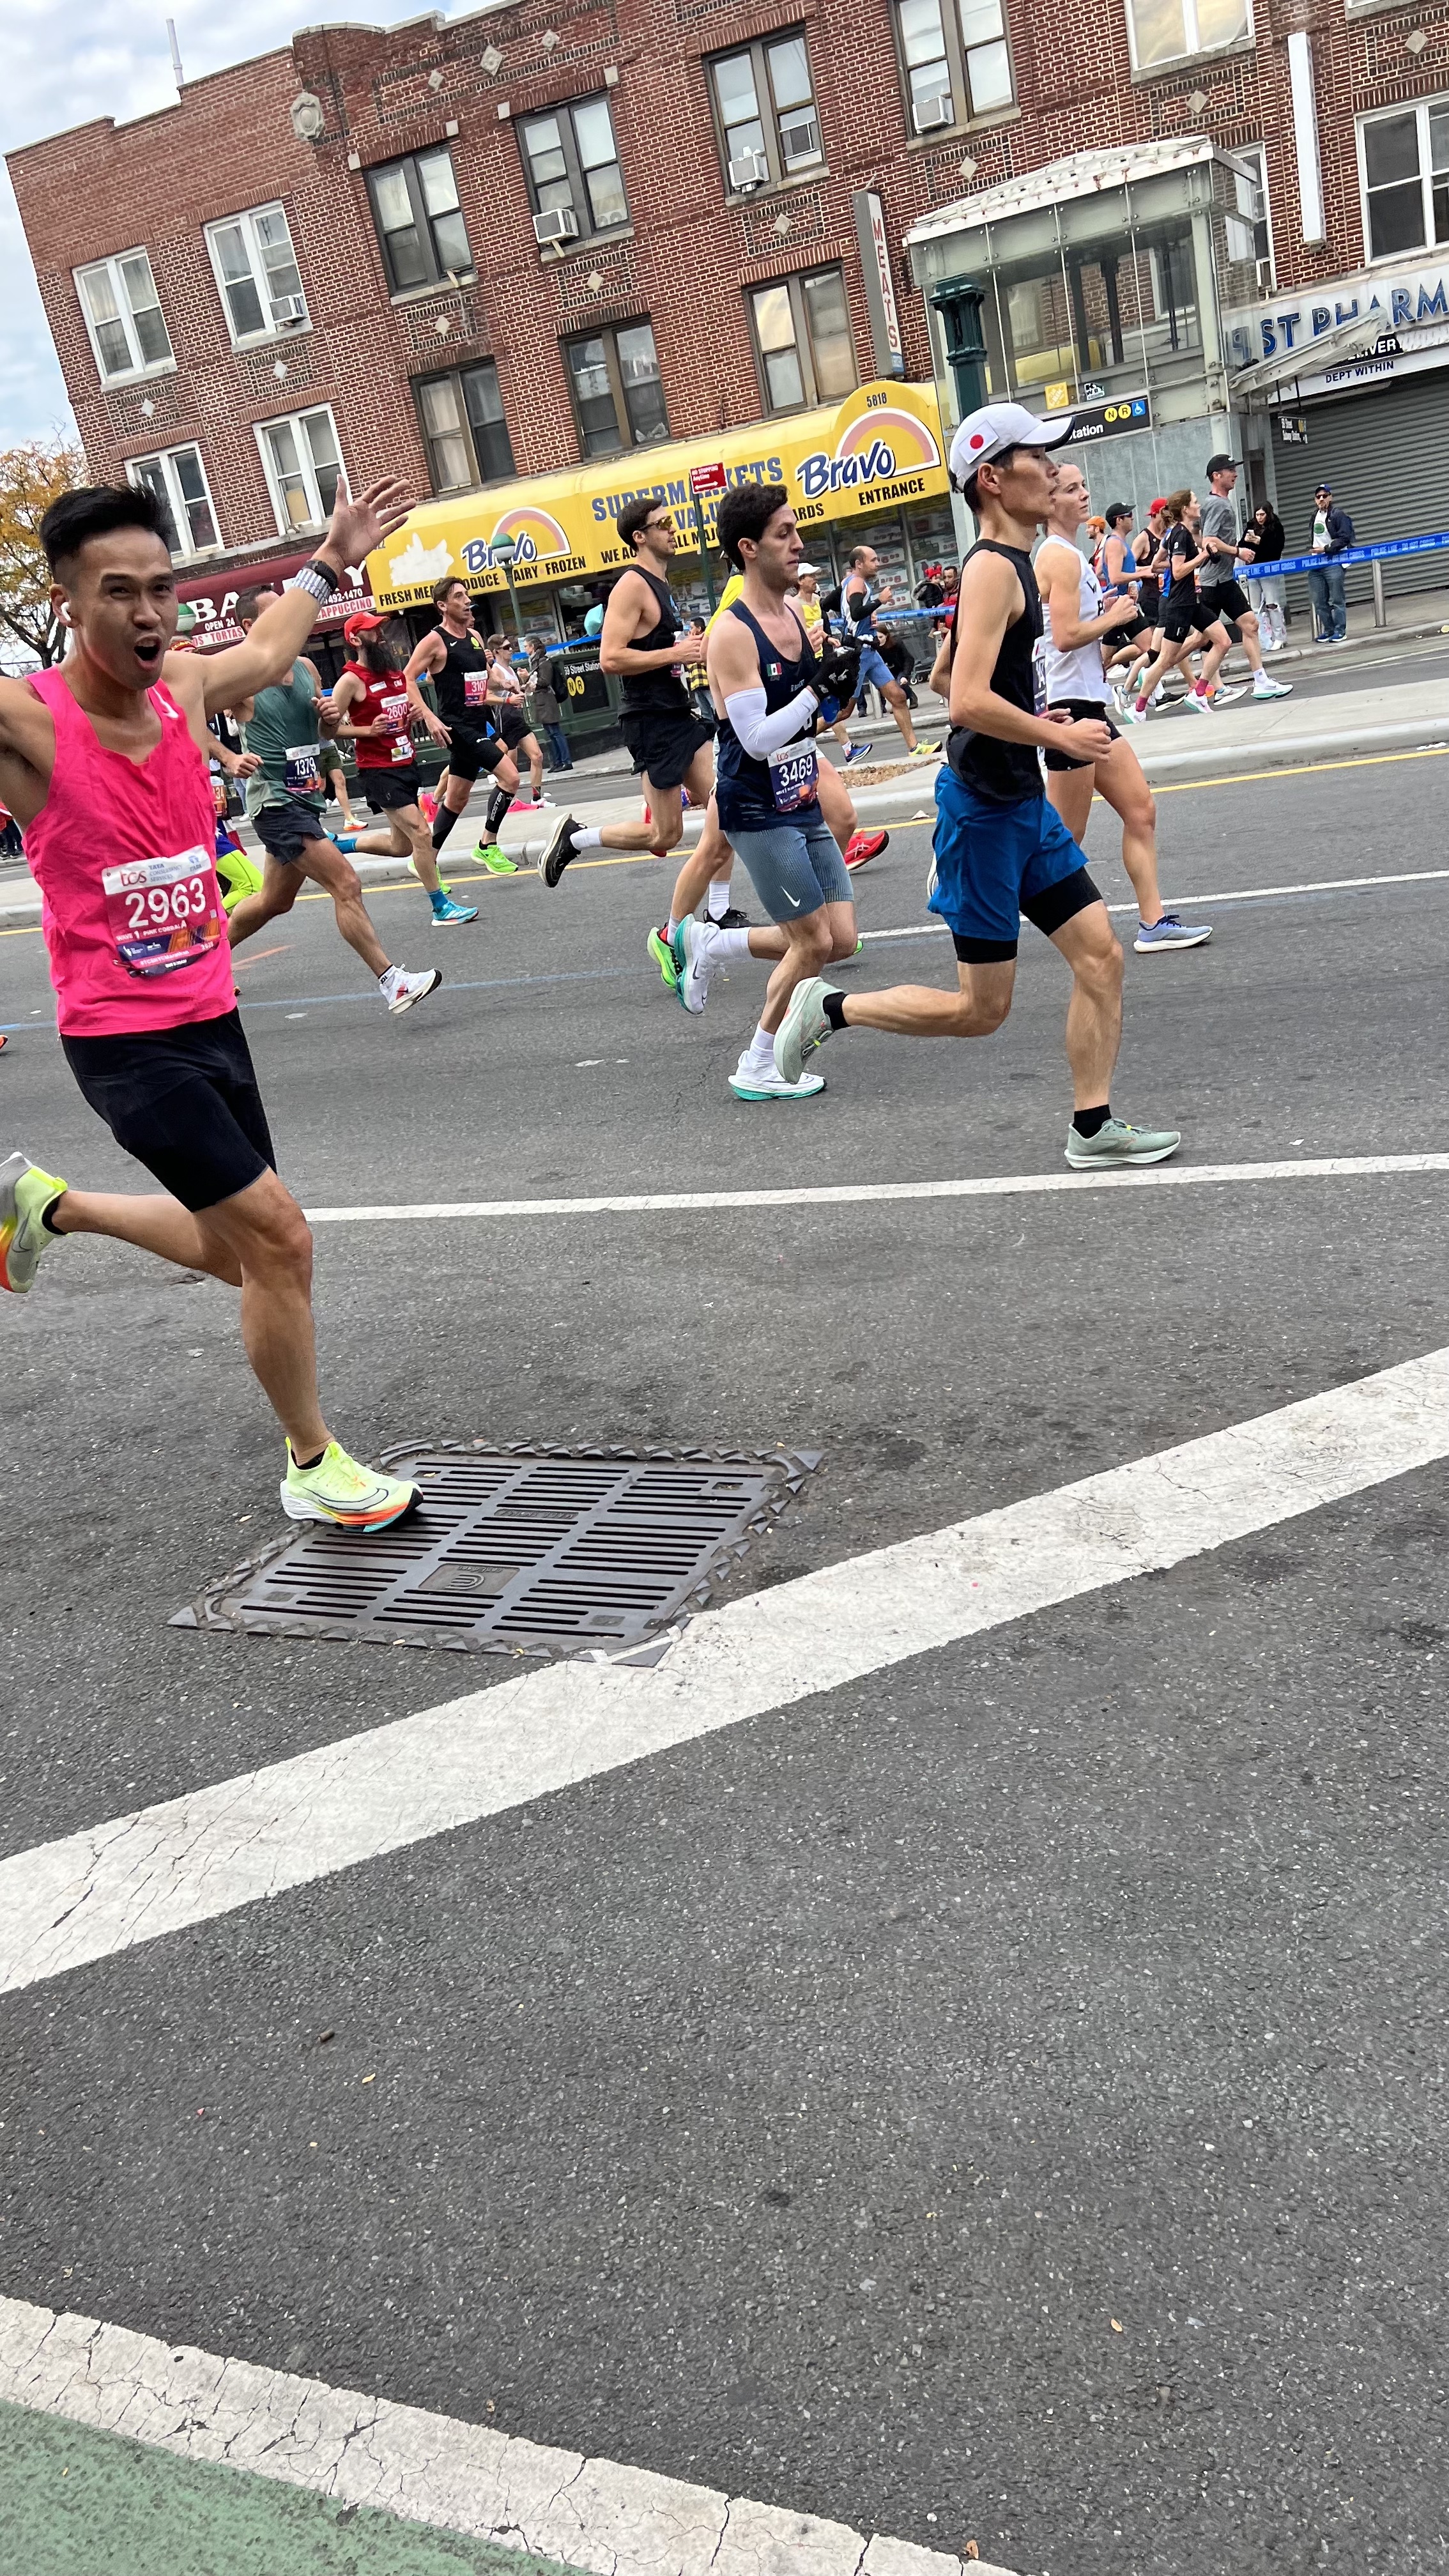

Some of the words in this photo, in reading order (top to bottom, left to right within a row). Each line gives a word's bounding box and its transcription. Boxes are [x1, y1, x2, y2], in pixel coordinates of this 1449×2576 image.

[871, 217, 898, 348] MEATS
[1260, 312, 1301, 356] ST
[1326, 370, 1352, 383] DEPT
[1355, 360, 1394, 376] WITHIN
[796, 440, 894, 496] Bravo
[591, 456, 783, 521] SUPRMKETS
[859, 477, 926, 506] ENTRANCE
[601, 548, 620, 564] WE
[792, 502, 824, 521] RDS
[462, 532, 536, 572] Brvo
[379, 589, 413, 606] FRESH
[464, 572, 500, 591] ODUCE
[513, 565, 538, 582] AIRY
[545, 555, 586, 576] FROZEN
[204, 619, 224, 632] OPEN
[226, 617, 236, 627] 24
[210, 627, 243, 643] TORTAS
[318, 597, 372, 619] APPUCCINO
[471, 680, 486, 693] 3107
[569, 681, 574, 692] N
[577, 679, 583, 691] R
[387, 703, 408, 719] 2600
[295, 756, 316, 776] 1379
[778, 754, 813, 787] 3469
[490, 792, 503, 822] BOOSTER
[125, 877, 206, 928] 2963
[116, 932, 133, 941] WAVE
[134, 930, 140, 940] 1
[142, 928, 158, 937] PINK
[181, 919, 187, 929] A
